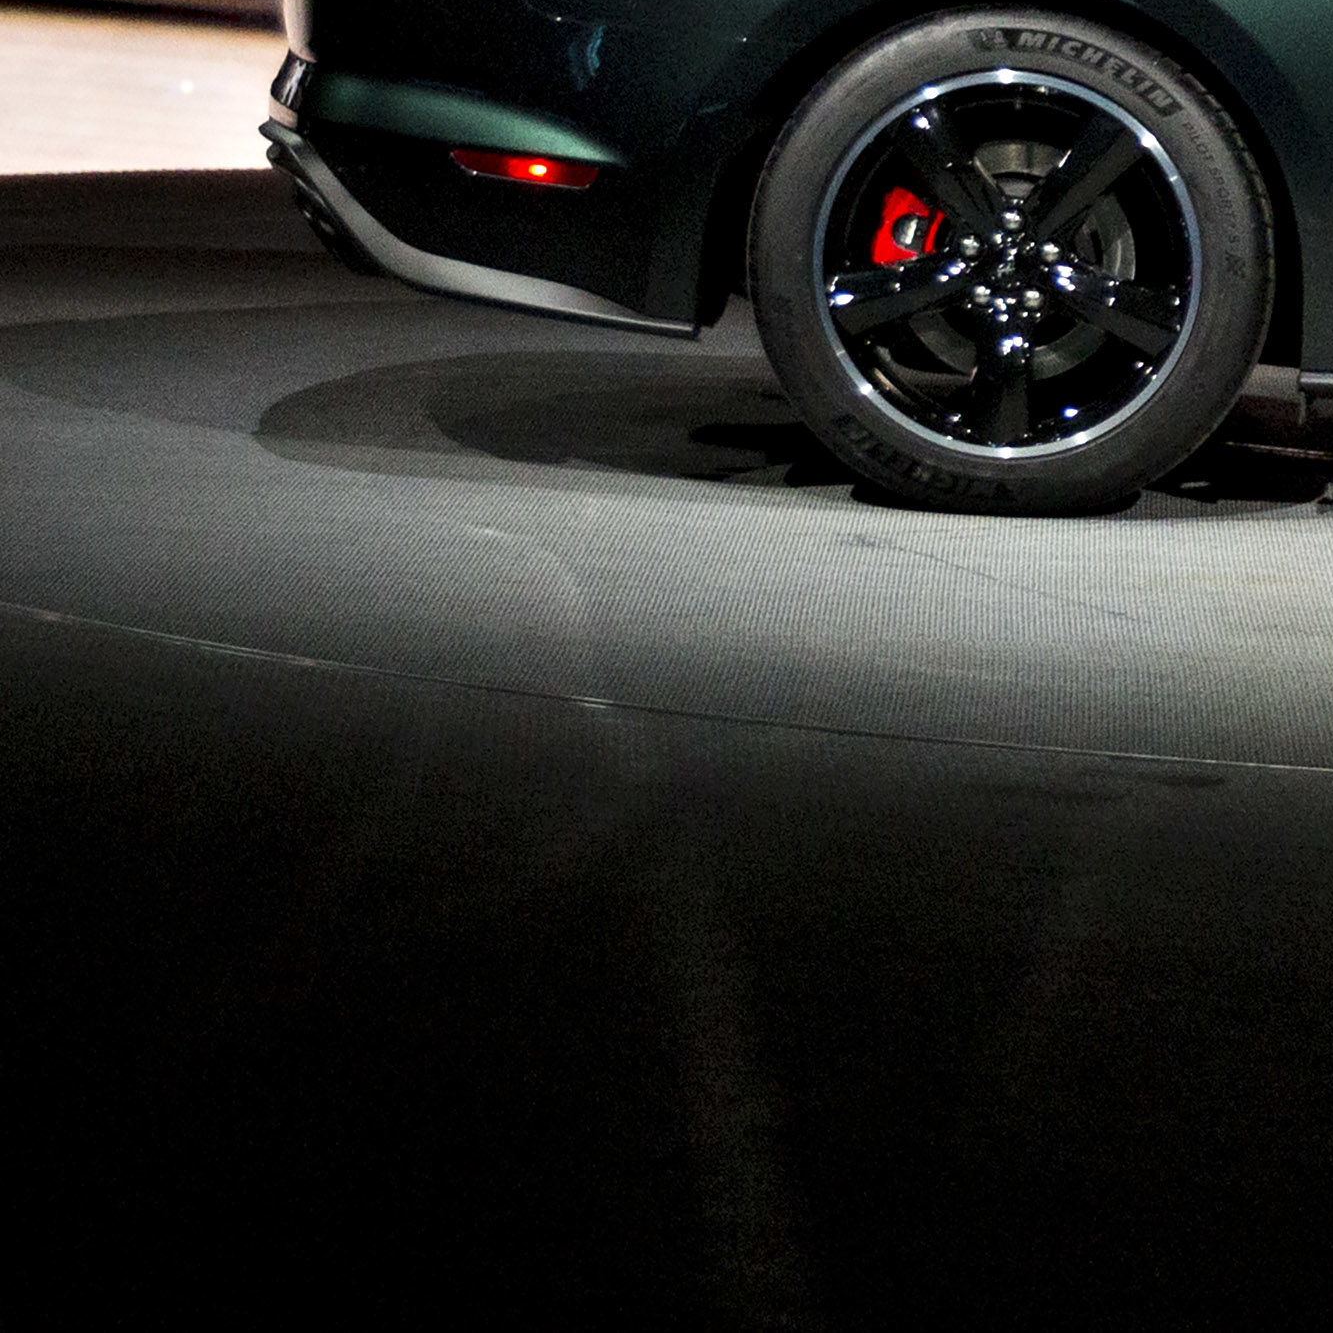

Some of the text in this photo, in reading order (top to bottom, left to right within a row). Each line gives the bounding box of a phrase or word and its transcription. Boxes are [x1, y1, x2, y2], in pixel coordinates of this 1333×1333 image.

[1016, 30, 1175, 108] MICHELIN
[1183, 121, 1216, 162] PILOT
[1209, 167, 1236, 220] SPORT
